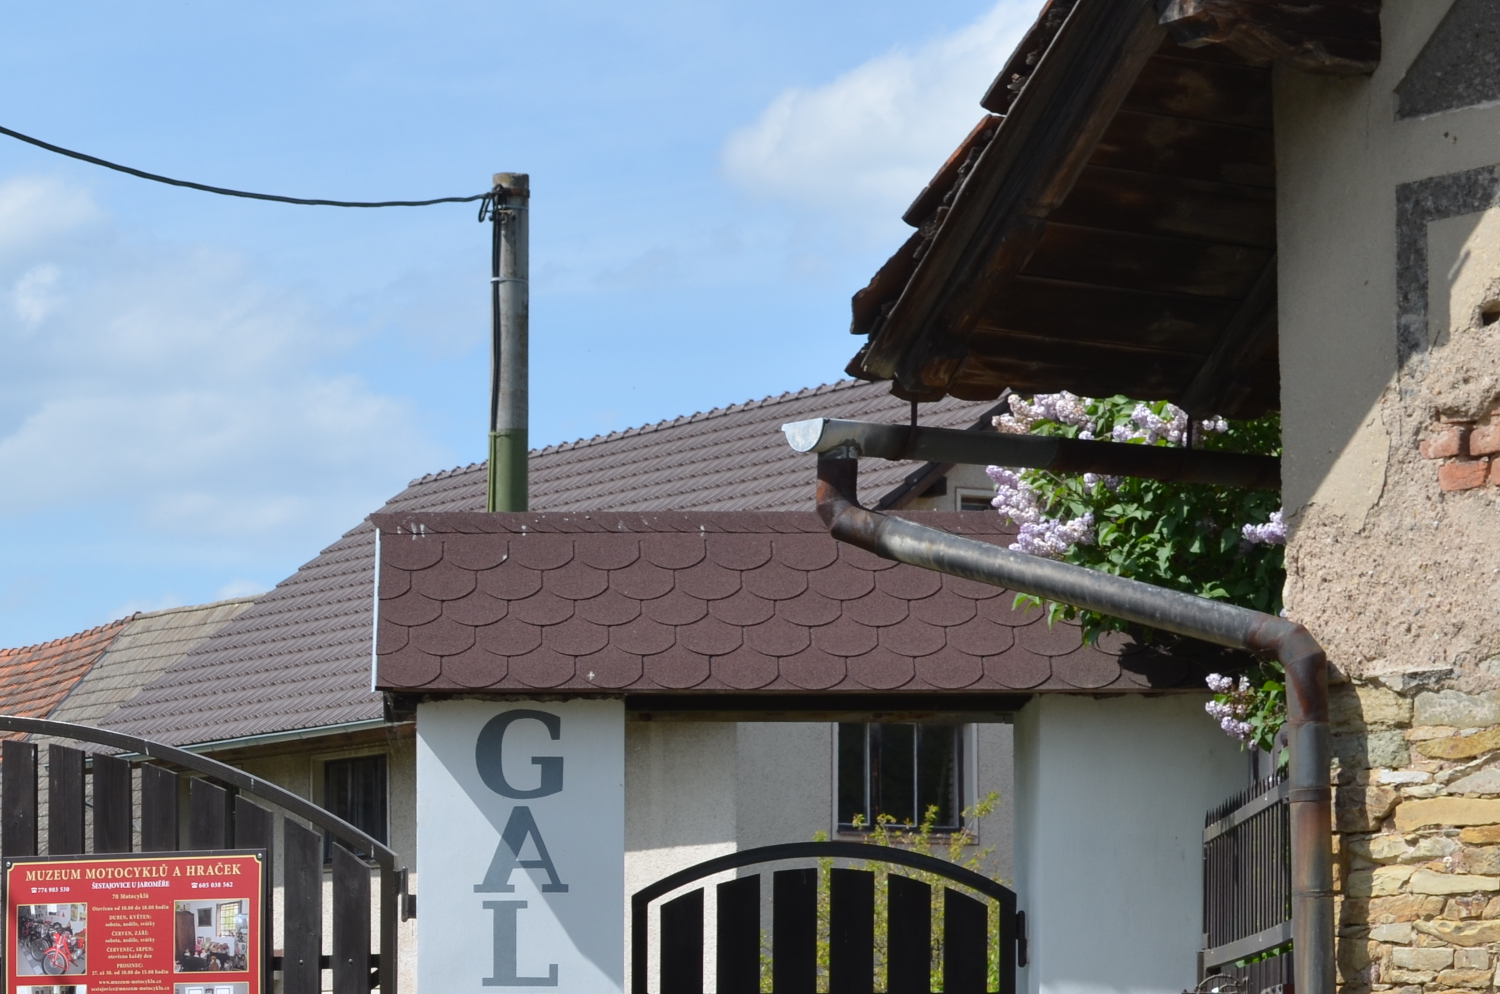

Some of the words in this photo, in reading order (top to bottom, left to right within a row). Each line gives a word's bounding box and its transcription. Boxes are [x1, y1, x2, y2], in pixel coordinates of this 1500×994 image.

[26, 869, 81, 881] MUZEUM
[85, 863, 168, 879] MOTOCYKLŮ
[172, 867, 181, 877] A
[186, 862, 241, 876] HRAČEK
[92, 881, 131, 890] ŠESTAJOVICE
[137, 880, 170, 889] JAROMĚŘE
